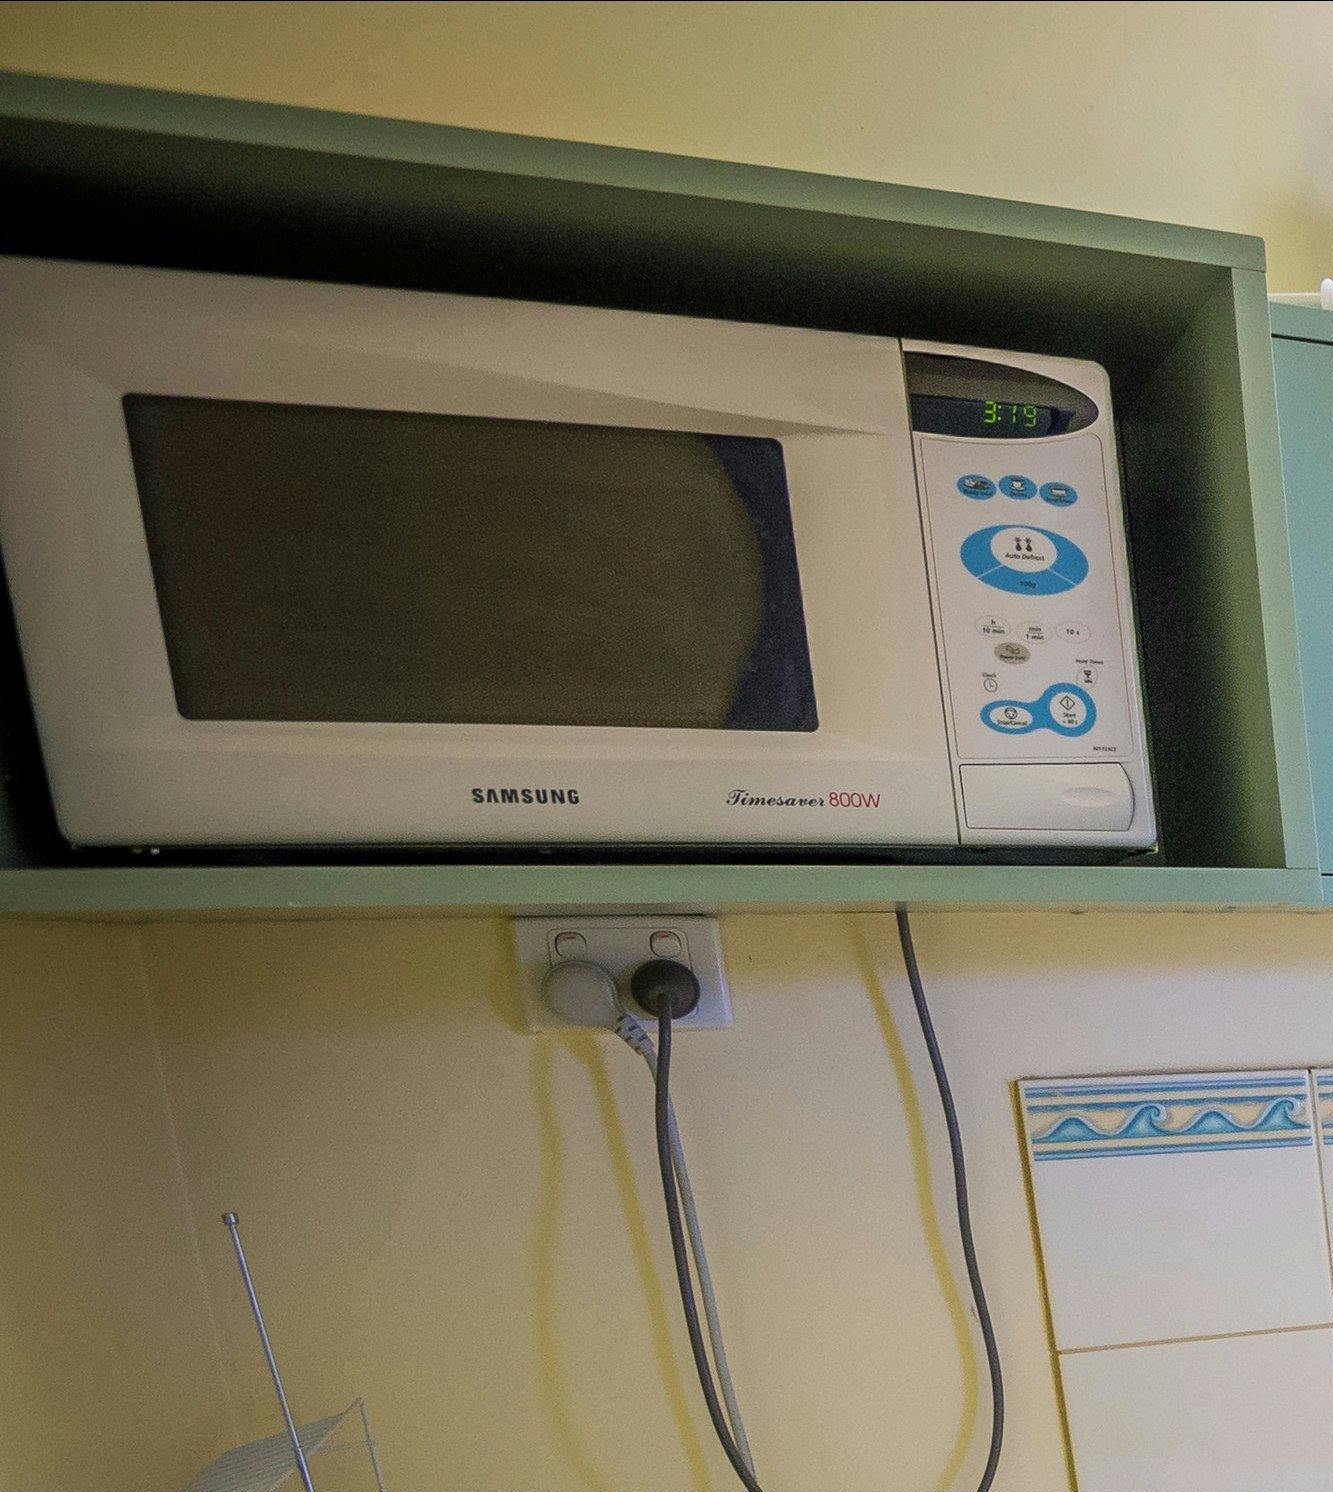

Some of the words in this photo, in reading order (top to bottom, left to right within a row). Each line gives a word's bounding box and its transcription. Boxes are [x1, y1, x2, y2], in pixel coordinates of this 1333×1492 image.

[983, 399, 1039, 428] 3:19
[471, 787, 580, 805] SAMSUNG
[725, 789, 825, 809] Timesaver
[828, 791, 881, 809] 800W
